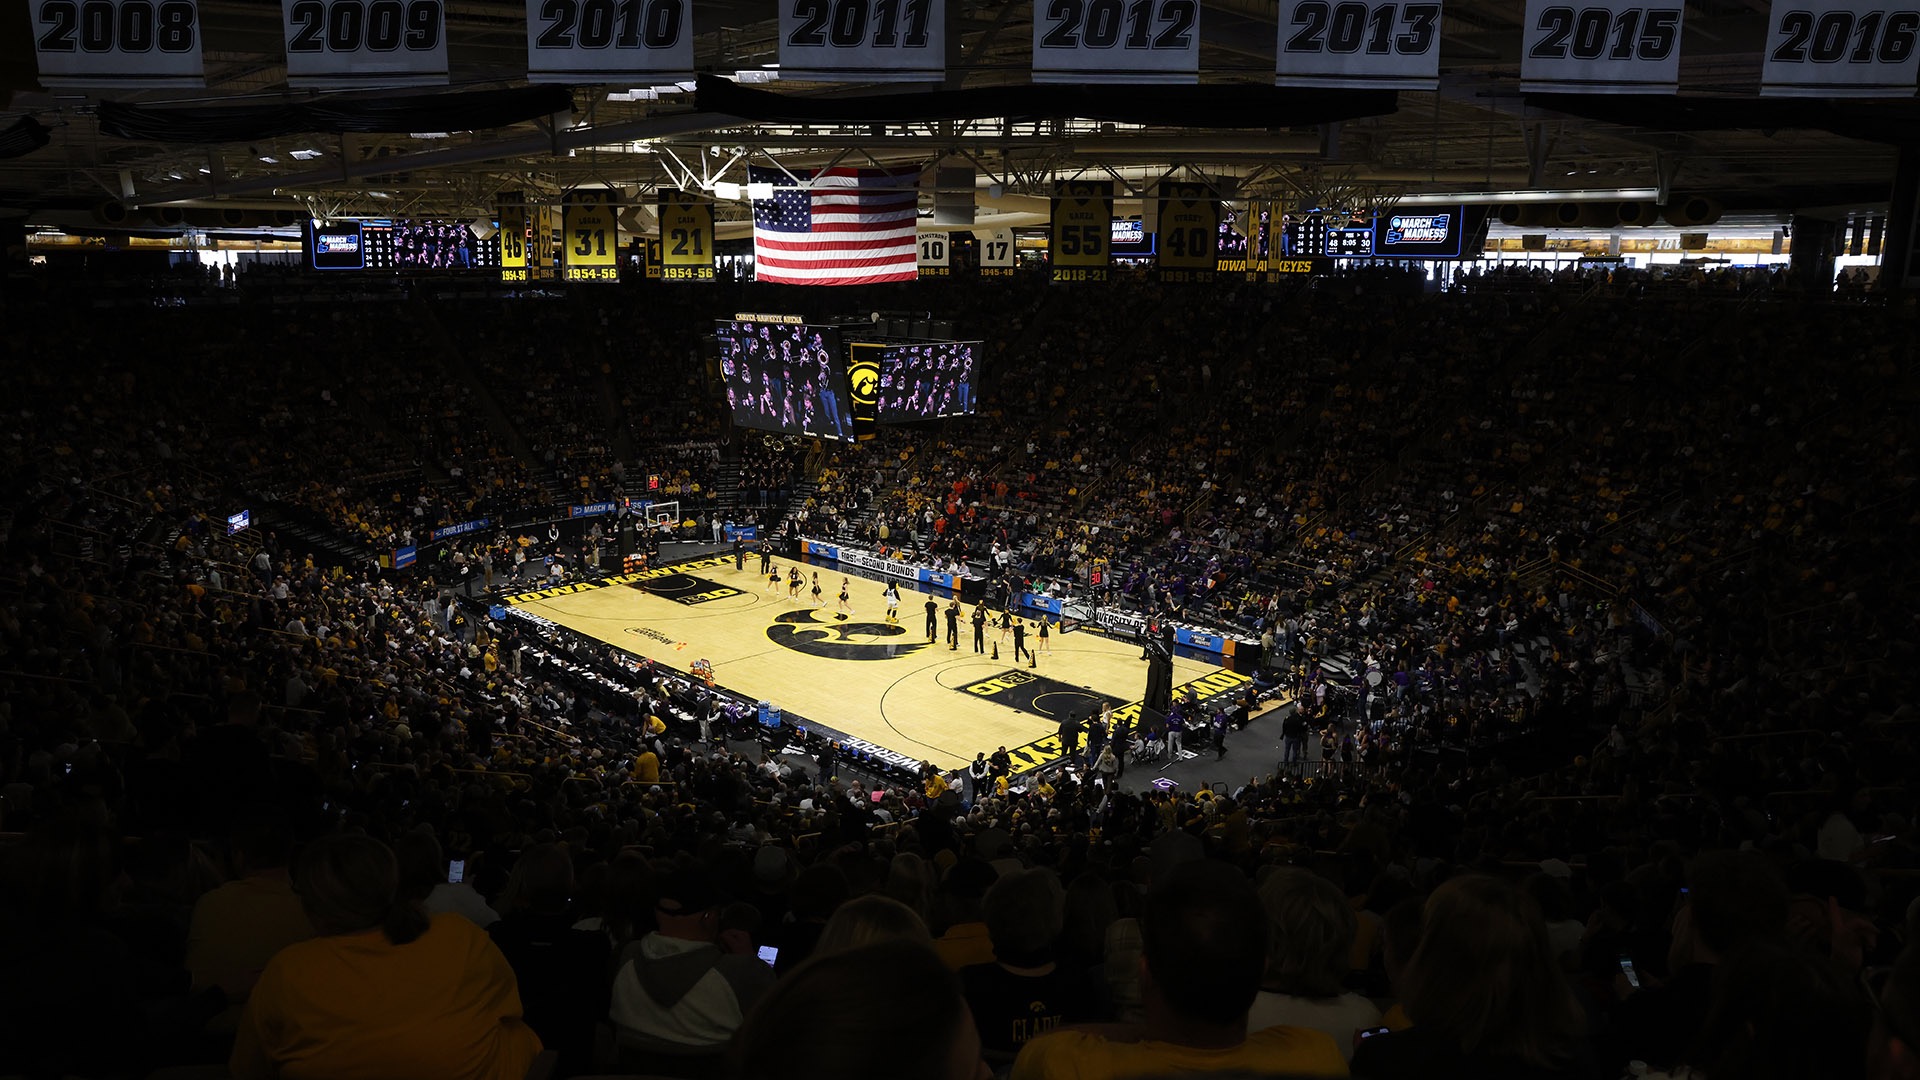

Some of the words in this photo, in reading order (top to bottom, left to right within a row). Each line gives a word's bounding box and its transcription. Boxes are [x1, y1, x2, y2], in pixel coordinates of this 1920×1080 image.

[38, 0, 194, 53] 2008
[288, 0, 440, 52] 2009
[535, 0, 684, 49] 2010
[788, 0, 932, 47] 2011
[1041, 0, 1198, 49] 2012
[1285, 2, 1441, 55] 2013
[1529, 6, 1681, 60] 2015
[1771, 10, 1920, 63] 2016
[1401, 218, 1432, 228] MARCH
[575, 229, 606, 255] 31
[671, 228, 703, 255] 21
[1062, 226, 1101, 255] 55
[1167, 228, 1207, 257] 40
[1403, 228, 1446, 239] MADNESS
[505, 232, 522, 258] 46
[921, 241, 944, 260] 10
[986, 242, 1009, 260] 17
[1329, 239, 1338, 247] 48
[1342, 239, 1357, 247] 8:05
[1361, 239, 1371, 247] 30
[567, 268, 617, 279] 1954-56
[663, 267, 713, 279] 1954-56
[919, 267, 950, 276] 986-89
[979, 267, 1014, 276] 1945-48
[1216, 259, 1247, 272] IOWA
[502, 270, 526, 281] 1954-56
[1052, 269, 1108, 281] 2018-21
[649, 480, 658, 490] 30
[583, 502, 606, 513] MARCH
[443, 525, 457, 536] FOUR
[841, 551, 857, 564] FIRST
[861, 557, 885, 571] SECOND
[886, 562, 915, 578] ROUNDS
[1091, 572, 1101, 585] 30
[503, 582, 600, 605] IOWA
